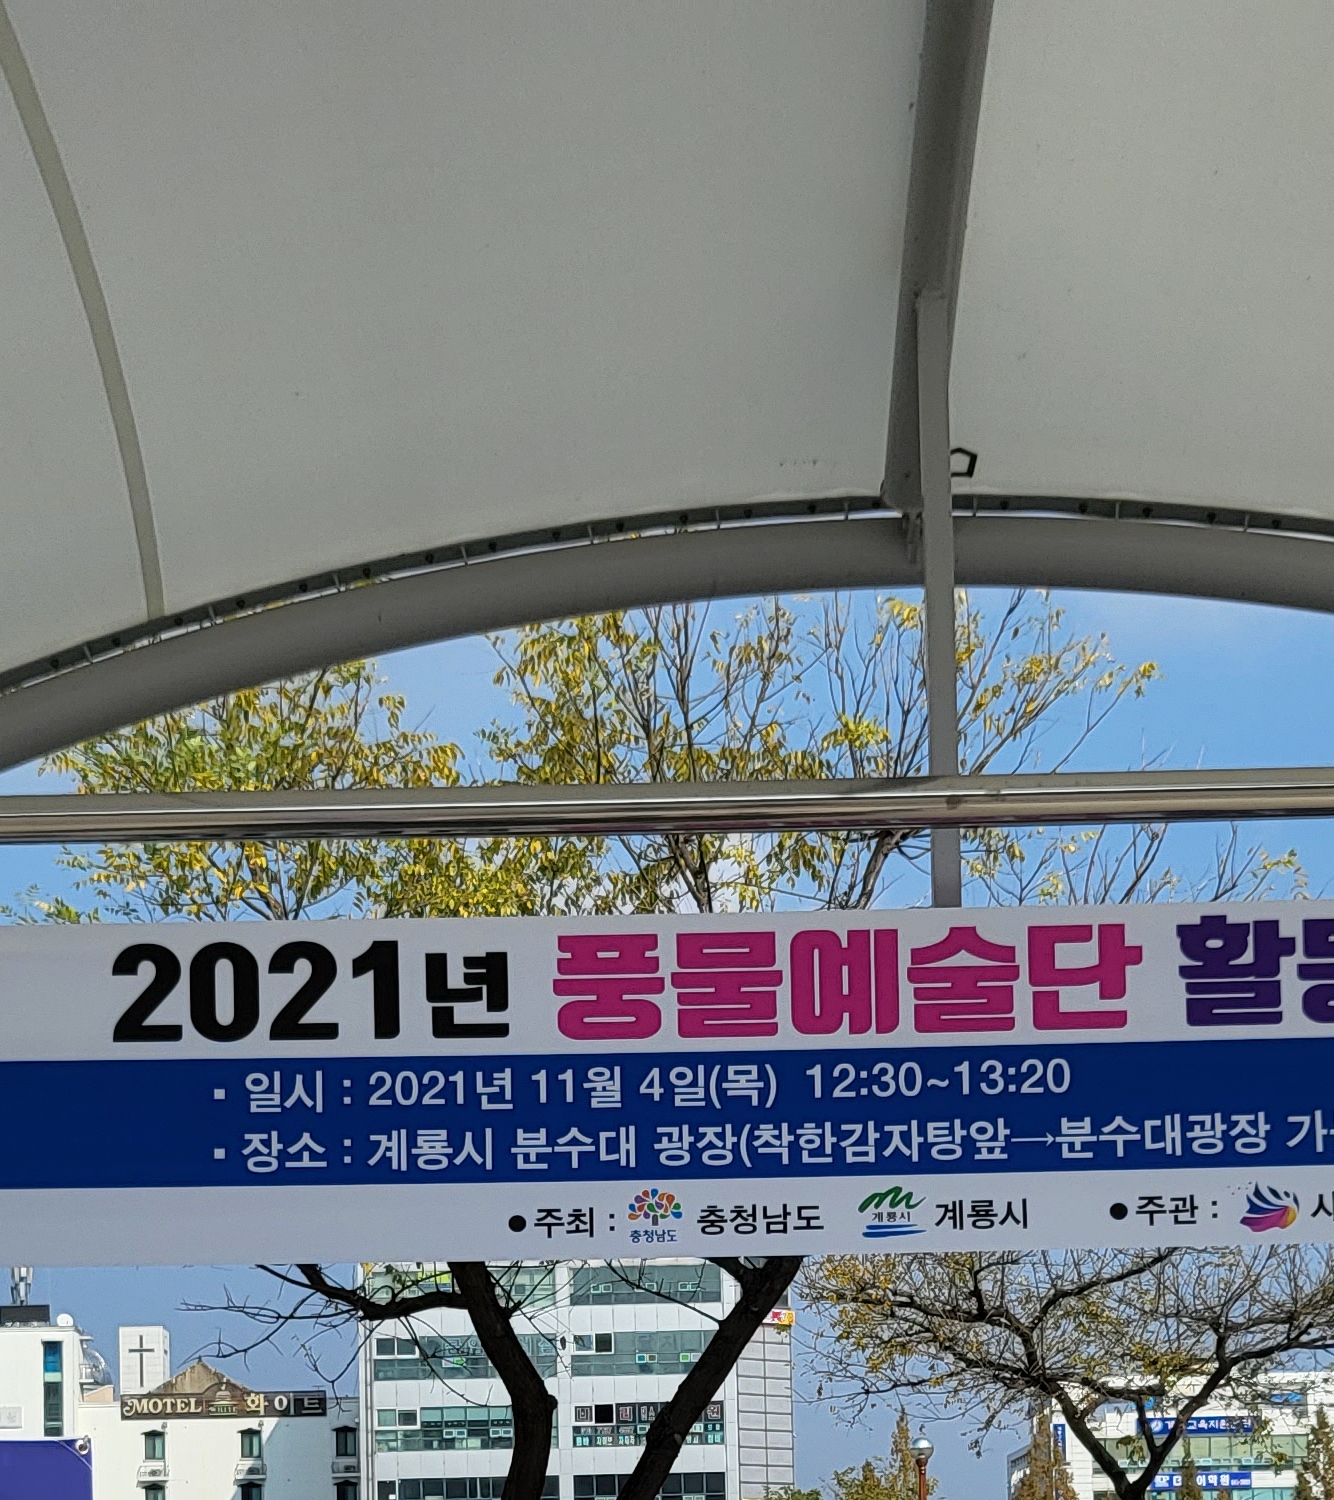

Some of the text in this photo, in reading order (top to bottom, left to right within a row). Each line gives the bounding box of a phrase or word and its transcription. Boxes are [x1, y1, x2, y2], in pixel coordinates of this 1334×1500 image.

[111, 939, 510, 1043] 2021년
[552, 923, 1143, 1041] 풍물예술단
[244, 1069, 324, 1113] 일시
[369, 1067, 514, 1110] 2021년
[531, 1065, 623, 1109] 11월
[639, 1062, 777, 1108] 4일(목)
[805, 1057, 1072, 1100] 12:30~13:20
[241, 1130, 327, 1172] 장소
[367, 1128, 495, 1171] 계룡시
[511, 1125, 637, 1171] 분수대
[534, 1206, 595, 1239] 주최
[696, 1203, 825, 1236] 충청남도
[934, 1197, 1029, 1231] 계룡시
[871, 1211, 912, 1223] 계룡시
[1135, 1194, 1199, 1226] 주관
[628, 1228, 678, 1244] 충청남도
[123, 1392, 323, 1417] MOTEL 화이트
